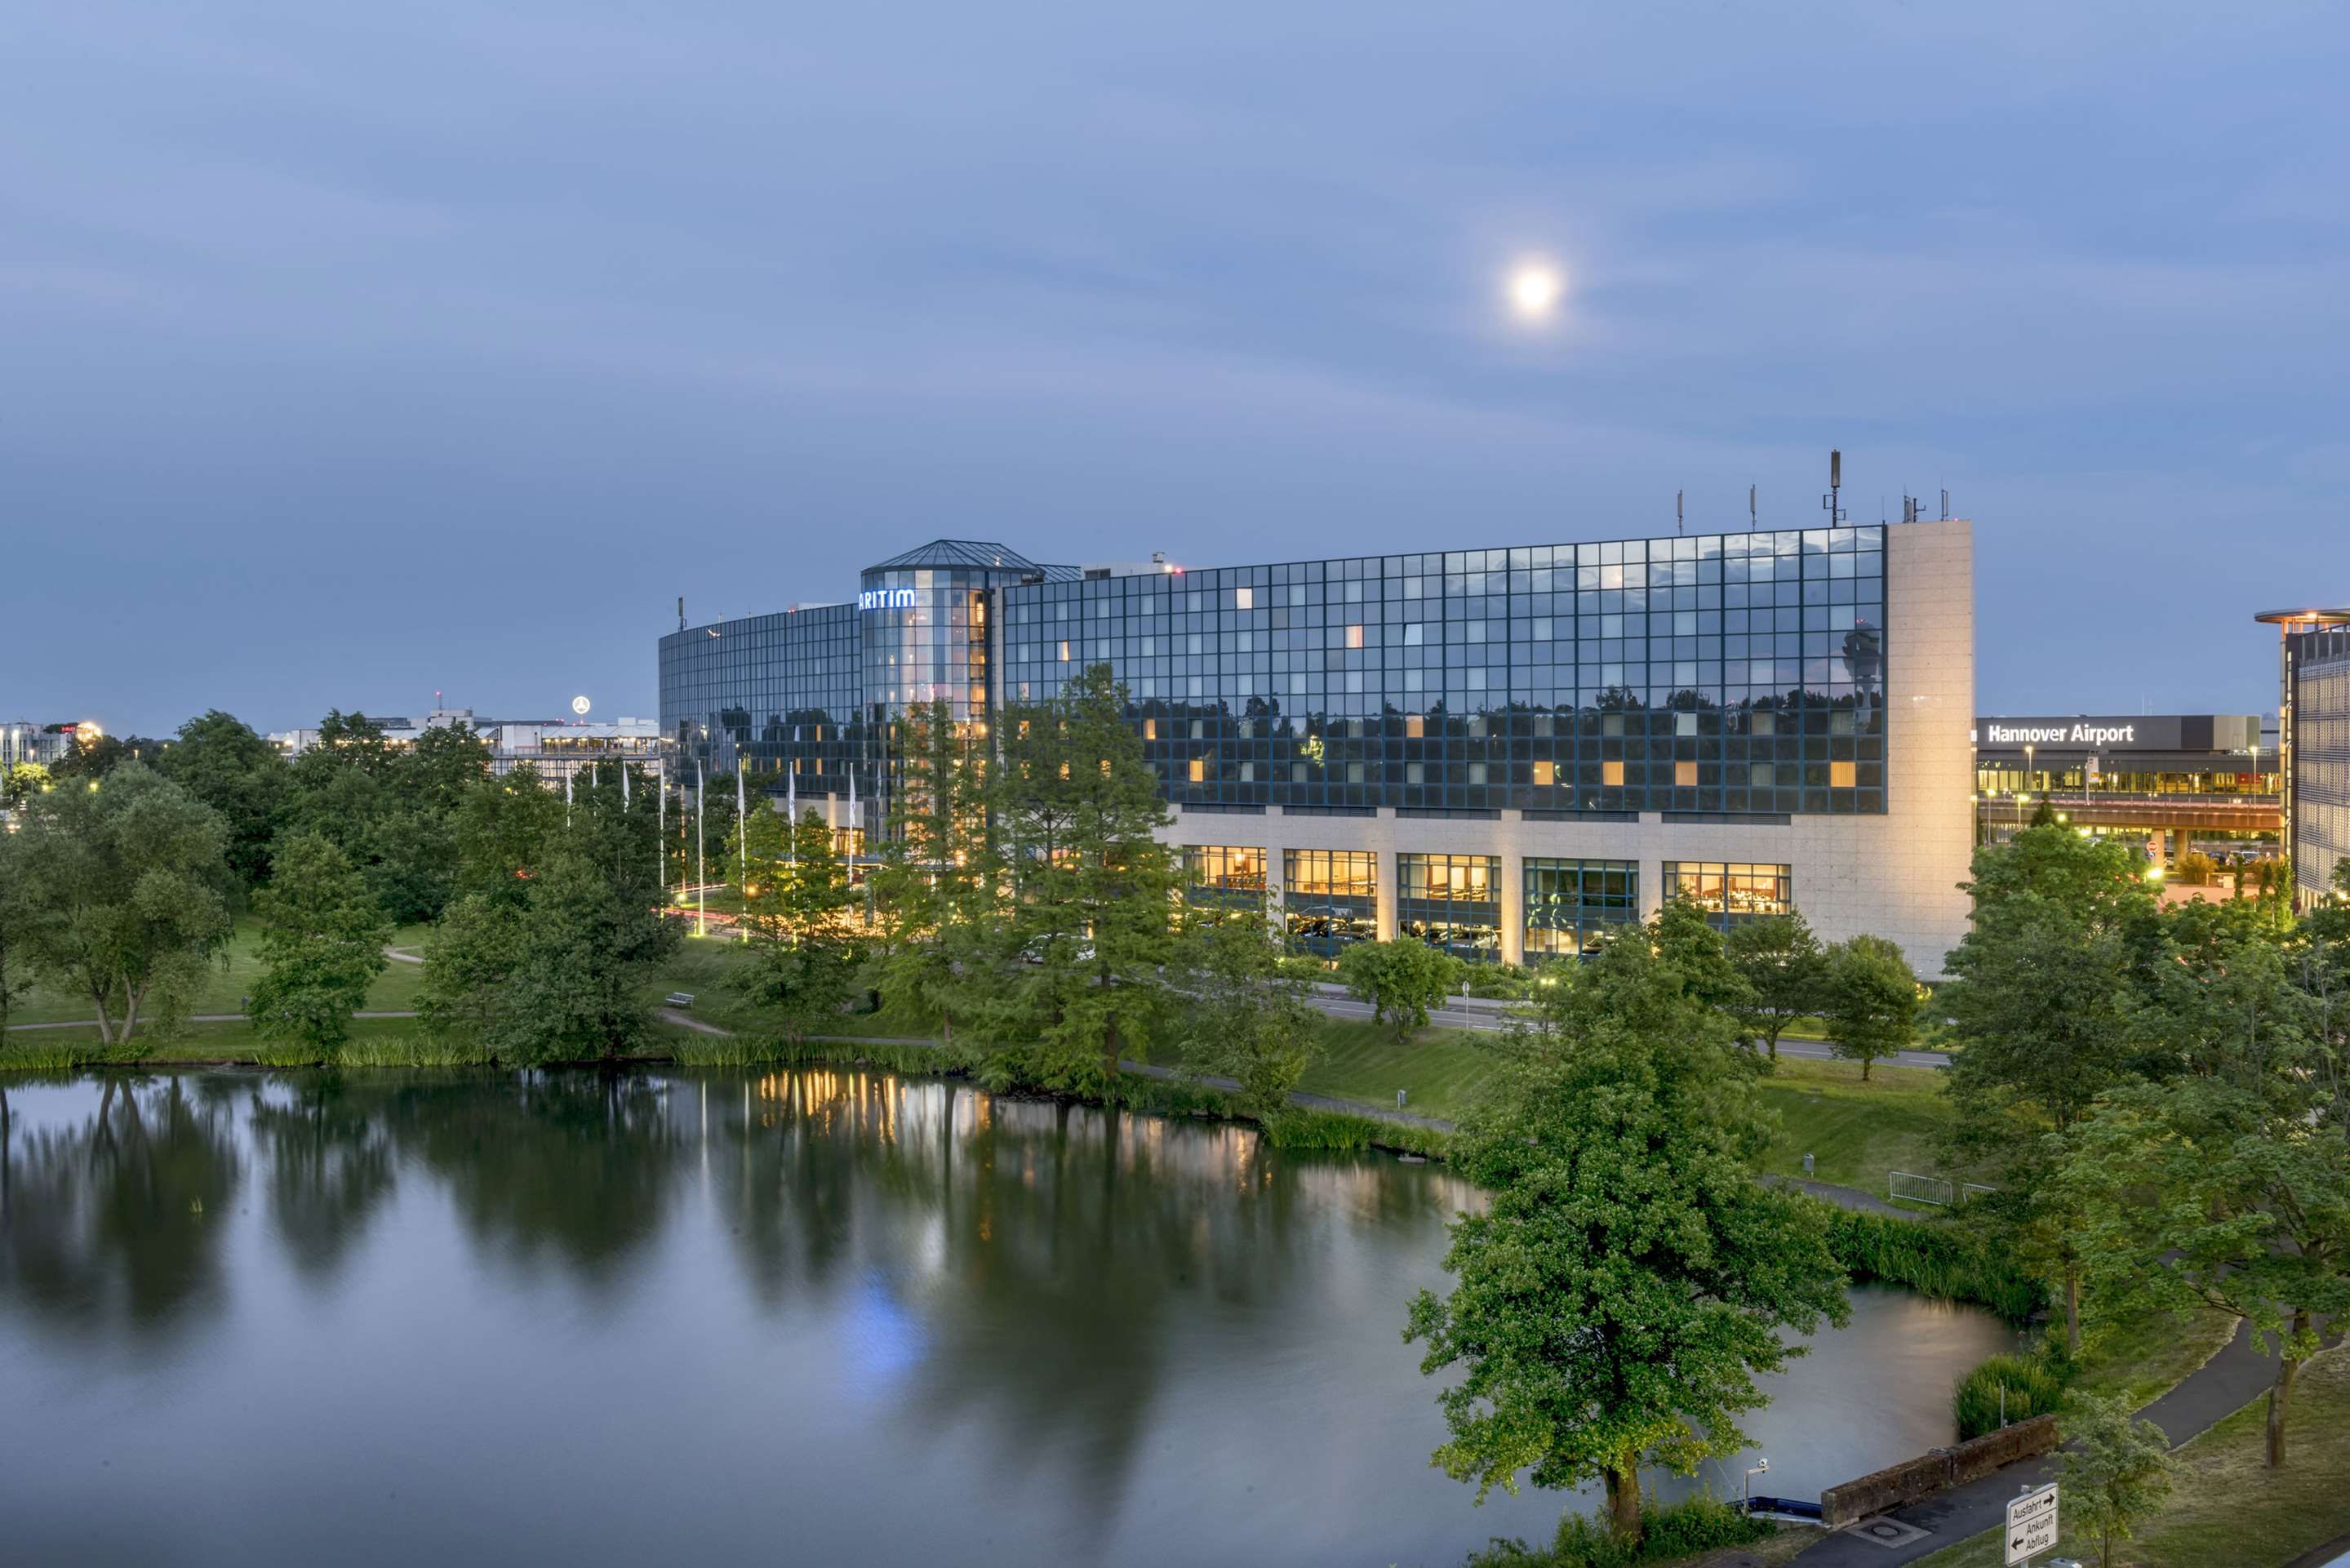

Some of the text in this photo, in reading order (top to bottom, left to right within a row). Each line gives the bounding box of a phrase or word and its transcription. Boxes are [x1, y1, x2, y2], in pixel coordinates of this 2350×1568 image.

[1988, 724, 2134, 746] Hannover Airport
[2013, 1499, 2041, 1520] Ausfahrt
[2027, 1514, 2053, 1535] Ankunft
[2026, 1534, 2049, 1551] Abflug
